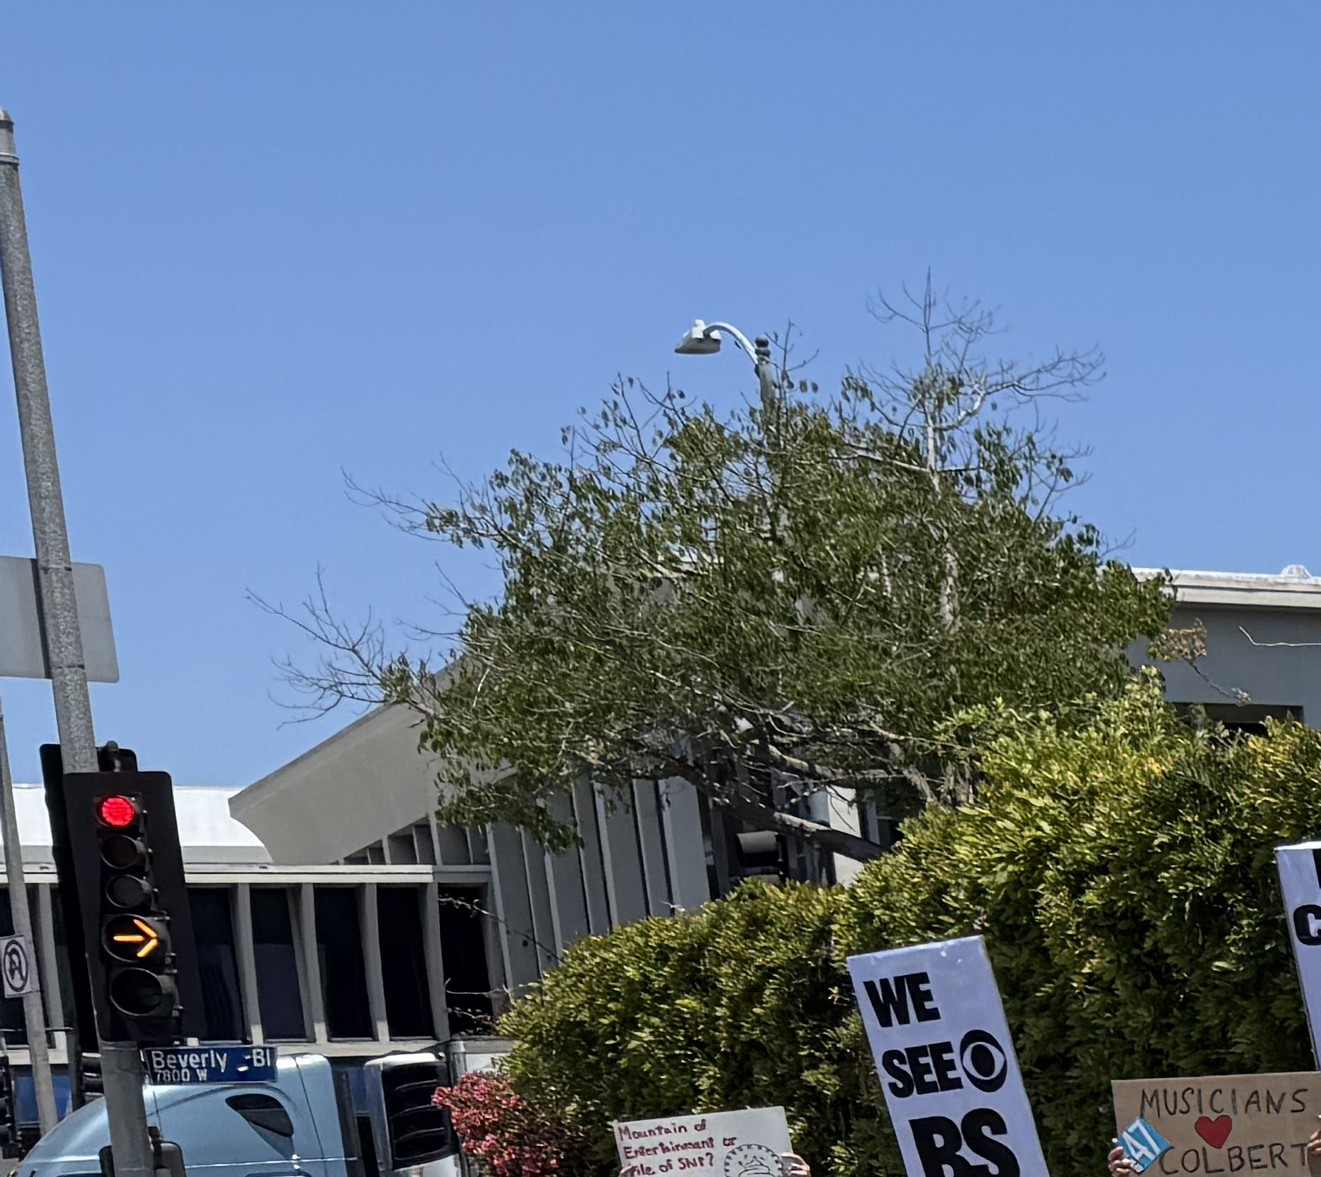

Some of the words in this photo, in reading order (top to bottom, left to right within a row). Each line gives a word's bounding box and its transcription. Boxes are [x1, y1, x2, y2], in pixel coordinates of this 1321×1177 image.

[863, 971, 941, 1028] WE
[151, 1050, 228, 1073] Beverly
[153, 1068, 191, 1082] 7800
[196, 1068, 208, 1081] W
[882, 1040, 964, 1099] SEE
[1140, 1087, 1309, 1119] MUSICIANS
[618, 1123, 688, 1142] Mountain
[694, 1118, 707, 1132] of
[722, 1137, 737, 1146] or
[1122, 1118, 1160, 1163] 47
[627, 1164, 656, 1177] ile
[659, 1158, 674, 1173] of
[1159, 1142, 1311, 1176] COLBERT
